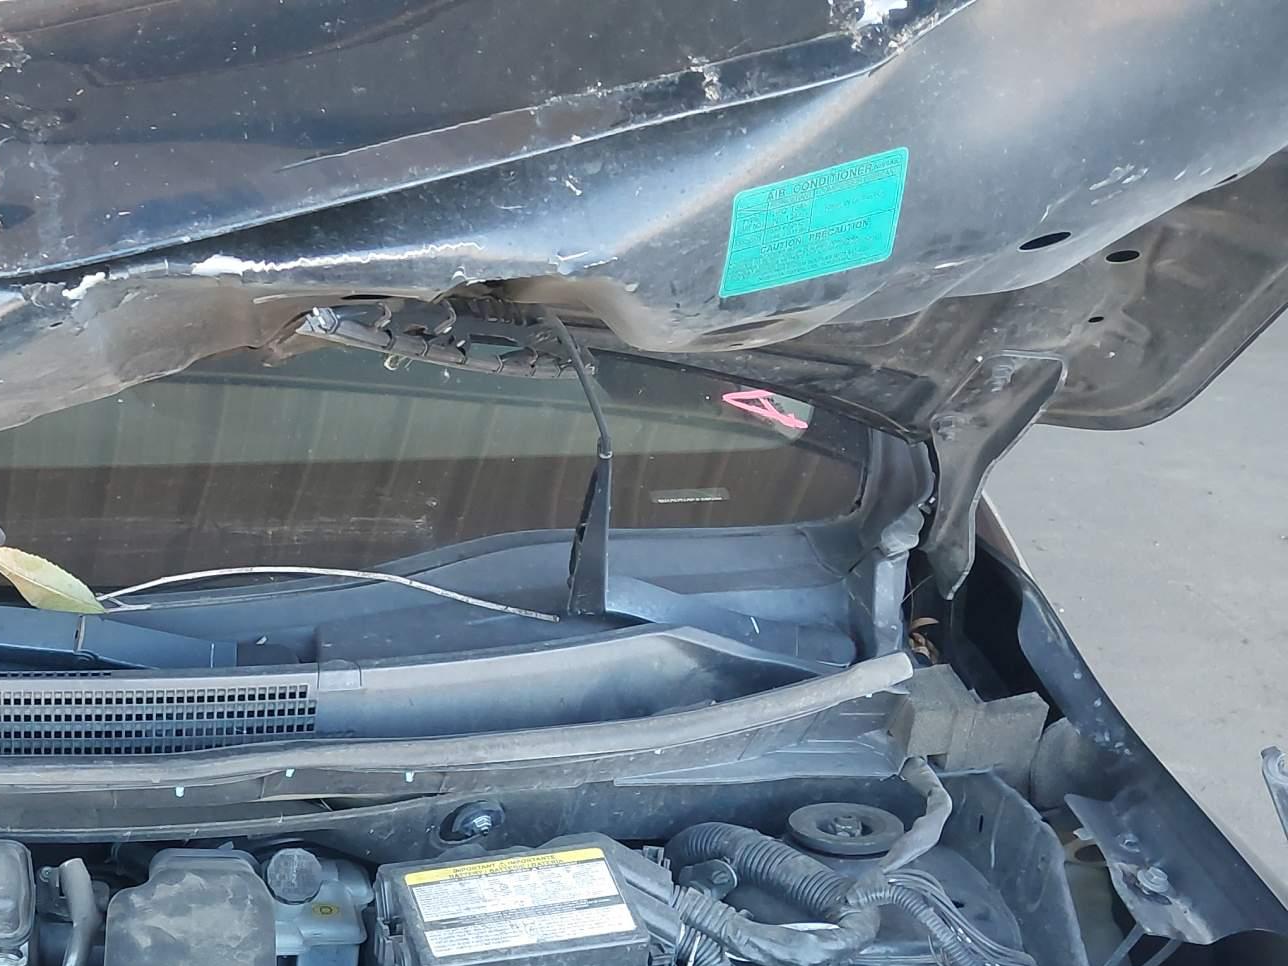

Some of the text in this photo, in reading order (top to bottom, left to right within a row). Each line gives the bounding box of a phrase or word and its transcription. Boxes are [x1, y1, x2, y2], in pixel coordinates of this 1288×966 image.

[767, 188, 786, 201] AIR
[793, 163, 873, 193] CONDITIONER
[760, 236, 802, 254] CAUTION
